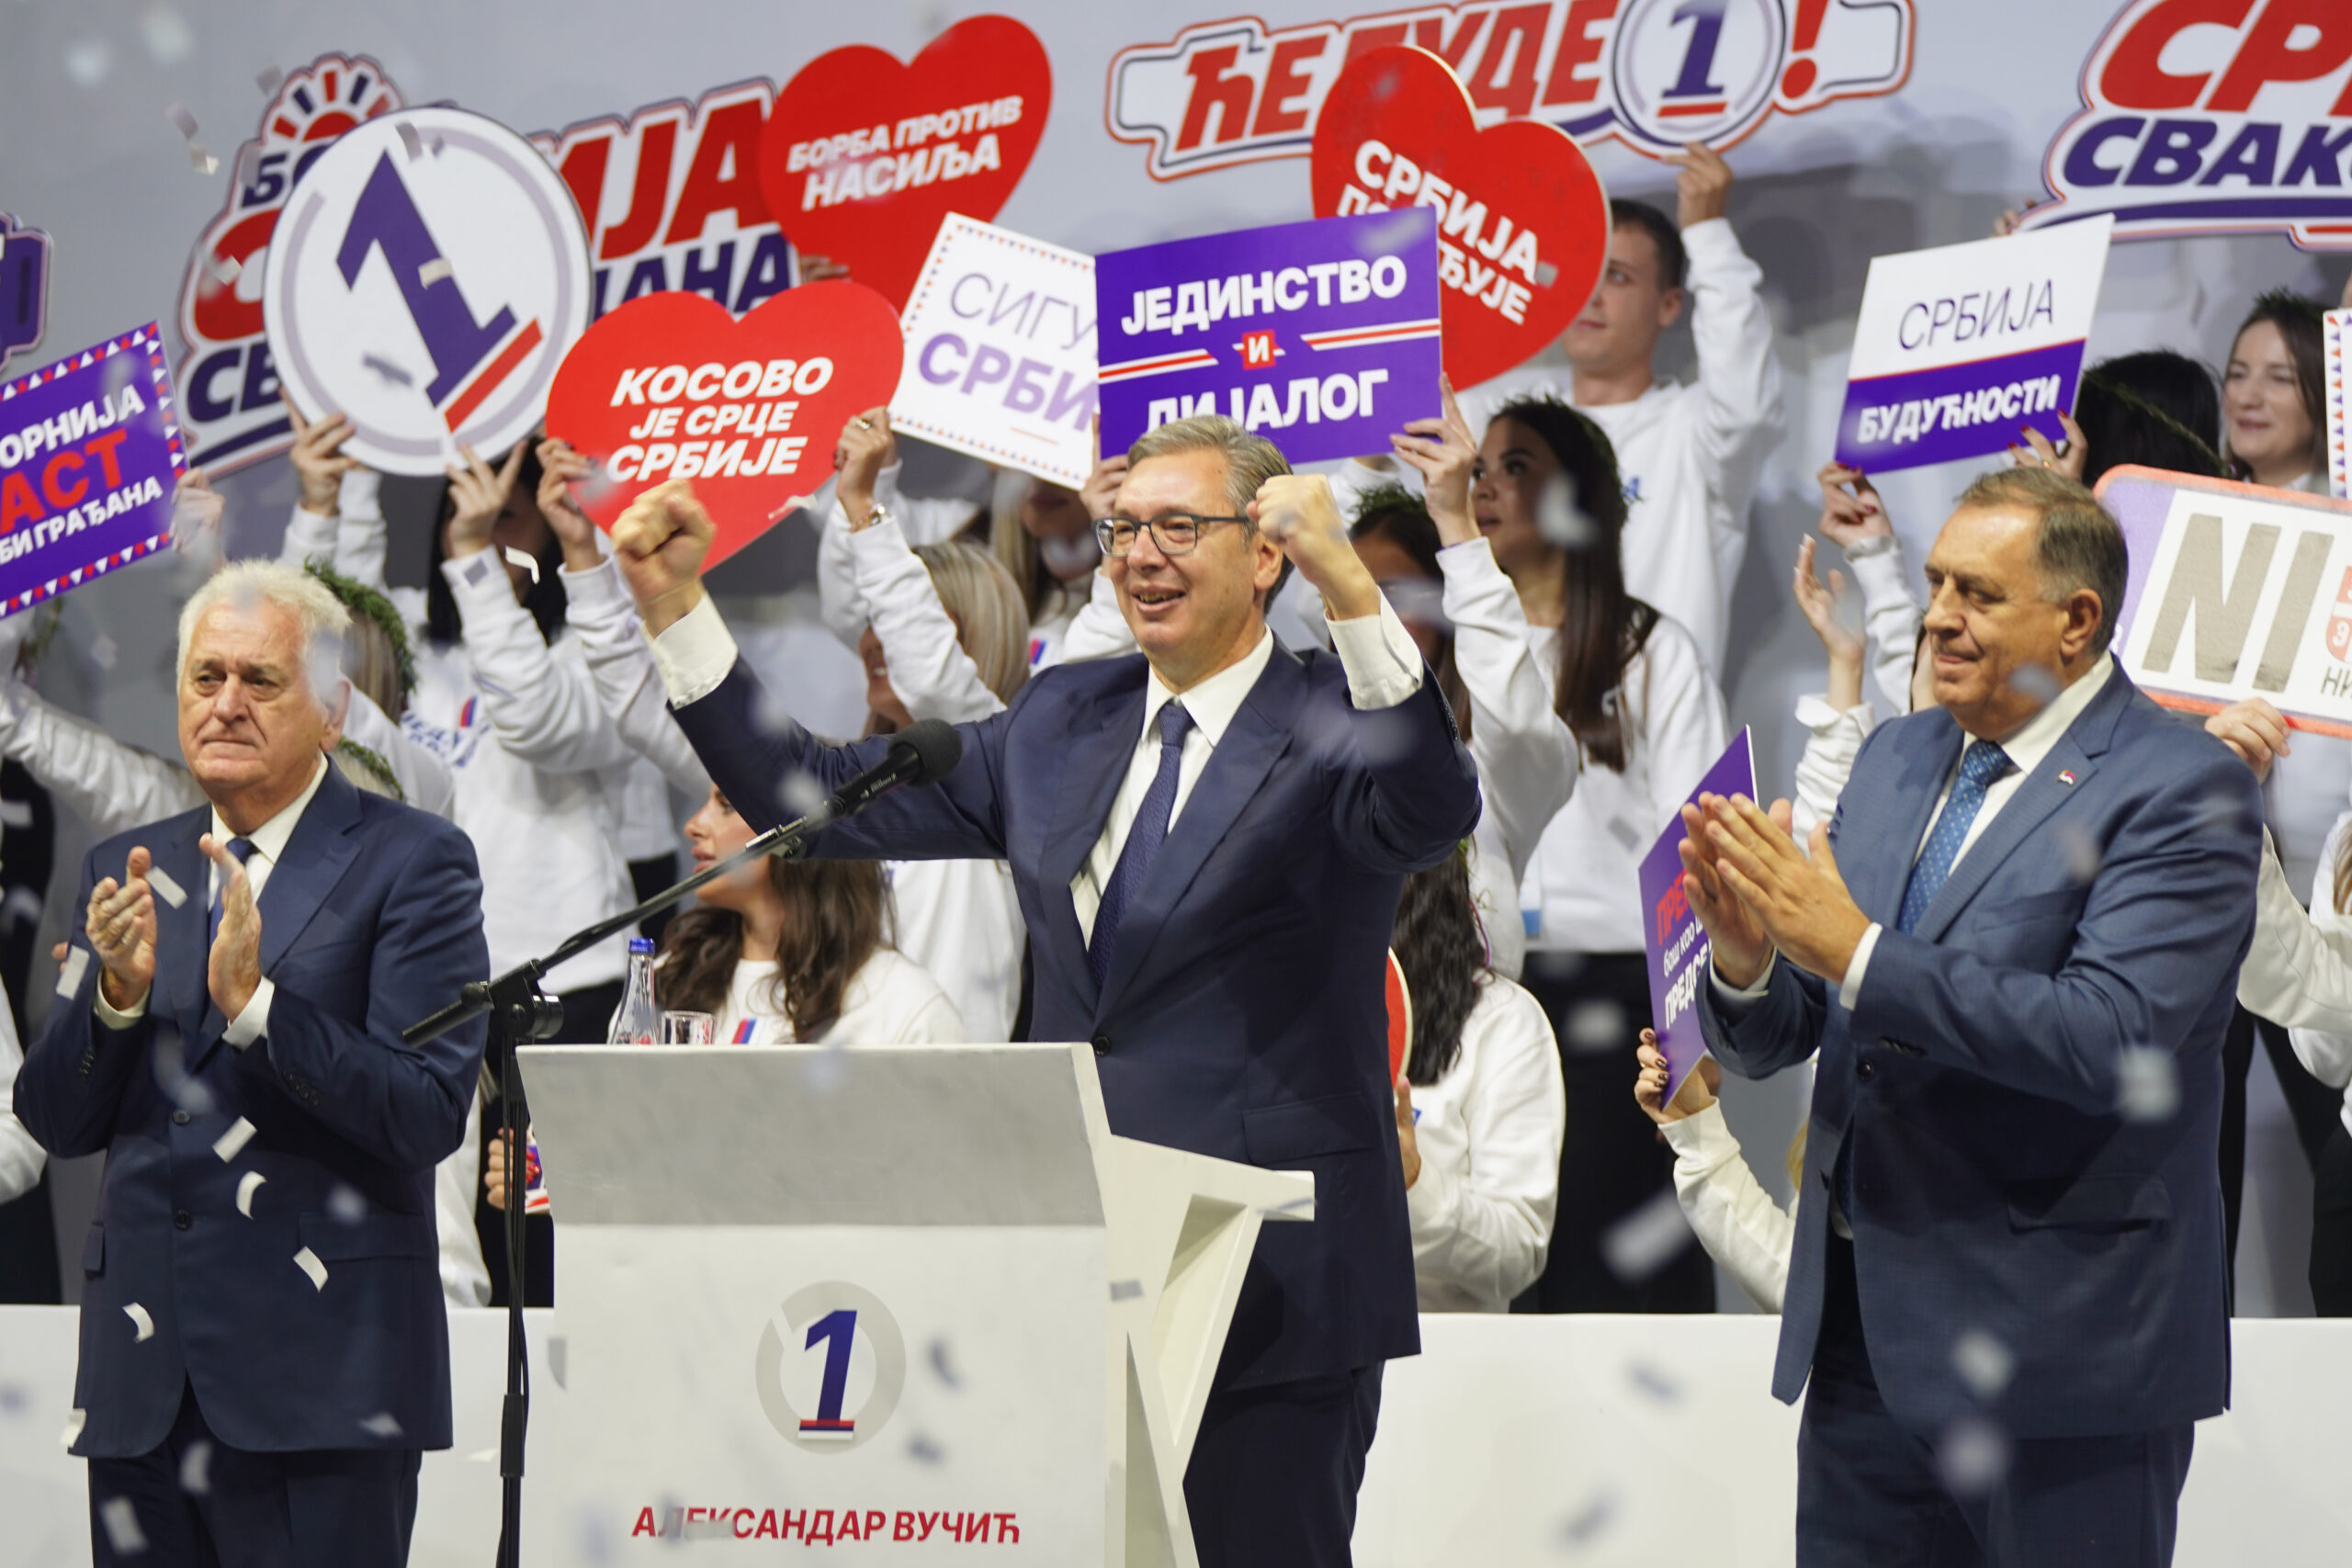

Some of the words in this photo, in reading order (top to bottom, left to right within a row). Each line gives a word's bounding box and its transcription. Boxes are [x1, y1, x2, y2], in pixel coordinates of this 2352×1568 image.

[1176, 34, 1329, 152] ЋЕ
[1340, 0, 1619, 118] УДЕ
[1661, 0, 1728, 97] 1
[2100, 0, 2352, 117] СР
[786, 124, 890, 173] БОРБА
[893, 95, 1023, 149] ПРОТИВ
[801, 133, 1001, 211] НАСИЉА
[1355, 140, 1538, 286] СРБИЈА
[336, 149, 516, 407] 1
[1121, 255, 1408, 336] ЈЕДИНСТВО
[1898, 278, 2052, 350] СРБИЈА
[610, 355, 834, 407] КОСОВО
[1247, 334, 1270, 364] И
[0, 384, 145, 468] ОРНИЈА
[629, 407, 684, 440] ЈЕ
[684, 400, 800, 438] СРЦЕ
[1857, 373, 2062, 445] БУДУЋНОСТИ
[0, 428, 127, 535] АСТ
[606, 436, 808, 483] СРБИЈЕ
[2142, 513, 2335, 694] NI
[1663, 939, 1680, 978] баш
[1679, 921, 1695, 954] као
[1664, 938, 1713, 1030] ПРЕДСЕ
[797, 1310, 857, 1431] 1
[891, 1511, 1021, 1544] ВУЧИЋ
